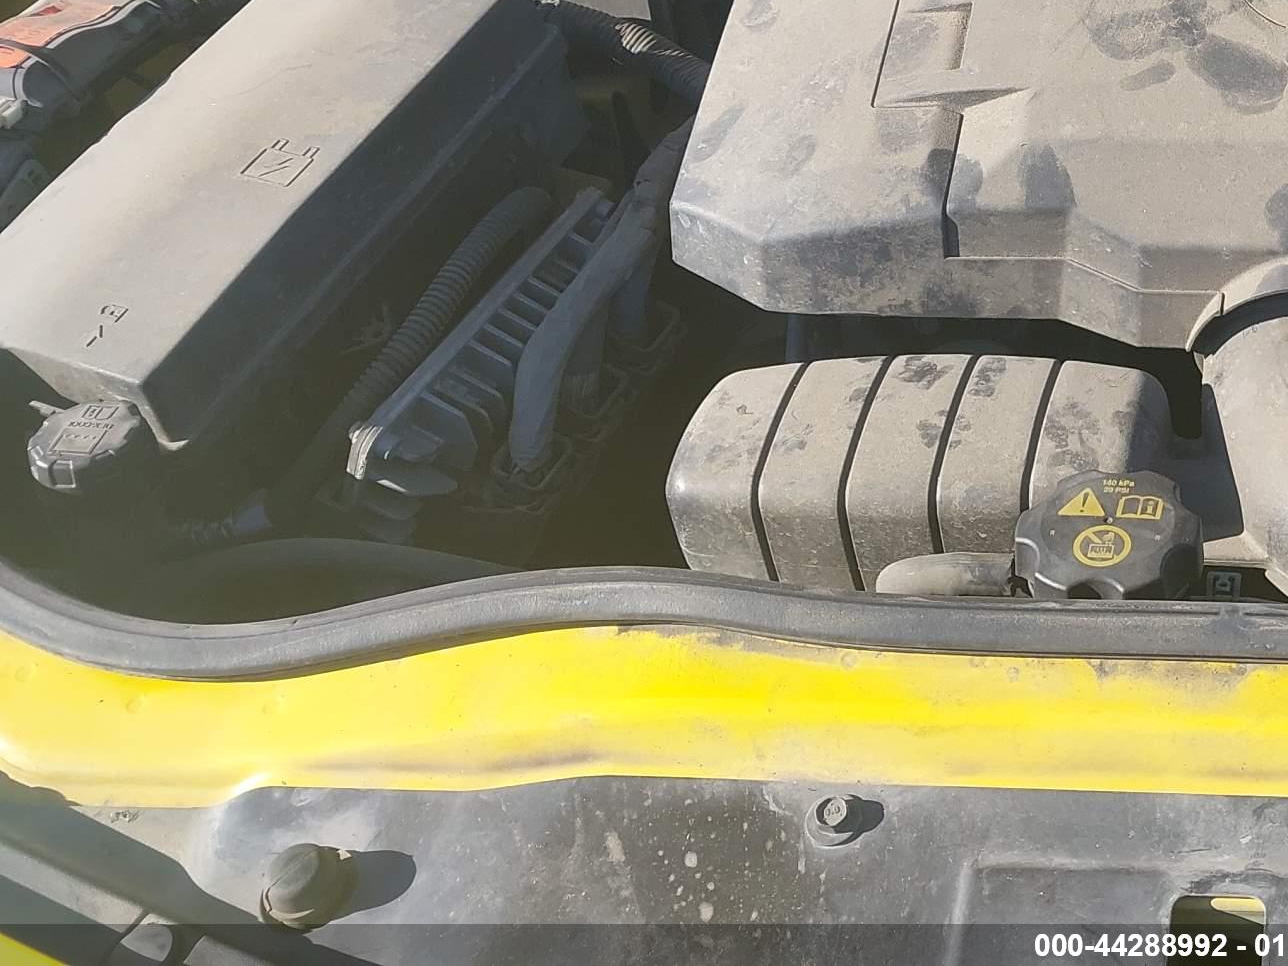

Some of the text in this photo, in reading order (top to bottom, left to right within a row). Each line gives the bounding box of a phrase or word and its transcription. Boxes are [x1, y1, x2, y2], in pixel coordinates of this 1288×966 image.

[1102, 479, 1135, 487] 140 kPa
[1115, 486, 1130, 494] PSI
